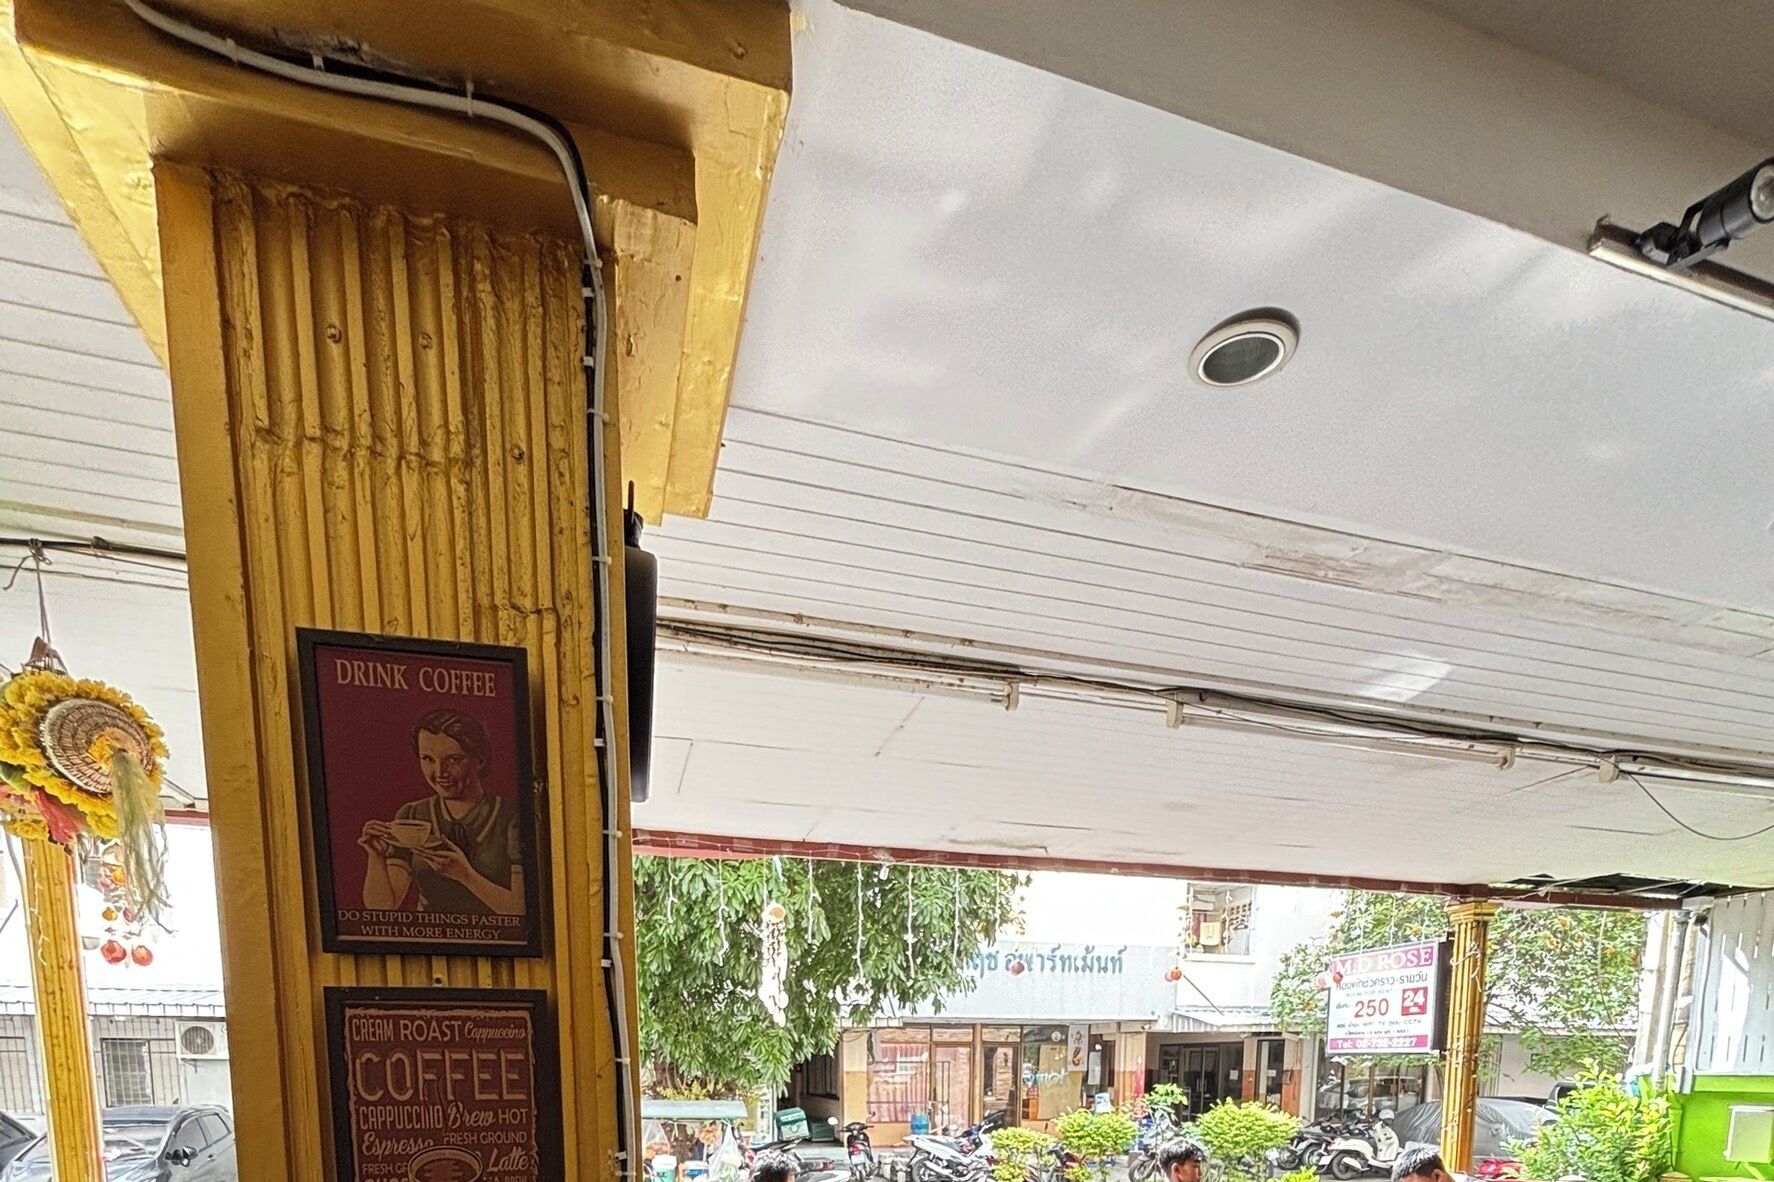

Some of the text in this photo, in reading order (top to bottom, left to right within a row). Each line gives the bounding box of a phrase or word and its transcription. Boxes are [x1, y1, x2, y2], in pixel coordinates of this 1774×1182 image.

[335, 659, 496, 697] DRINK COFFEE
[338, 910, 520, 927] DO STUPID THINGS FASTER
[361, 925, 501, 940] WITH MORE ENERGY
[1377, 948, 1432, 971] ROSE
[1354, 998, 1389, 1018] 250
[1403, 989, 1426, 1007] 24
[352, 1018, 526, 1042] CREAM ROAST Cappuccino
[355, 1049, 528, 1101] COFFEE
[359, 1102, 528, 1130] CAPPUCCINO Brew HOT
[443, 1131, 527, 1145] FRESH GROUND
[362, 1163, 393, 1175] FRESH
[486, 1146, 529, 1173] Latte
